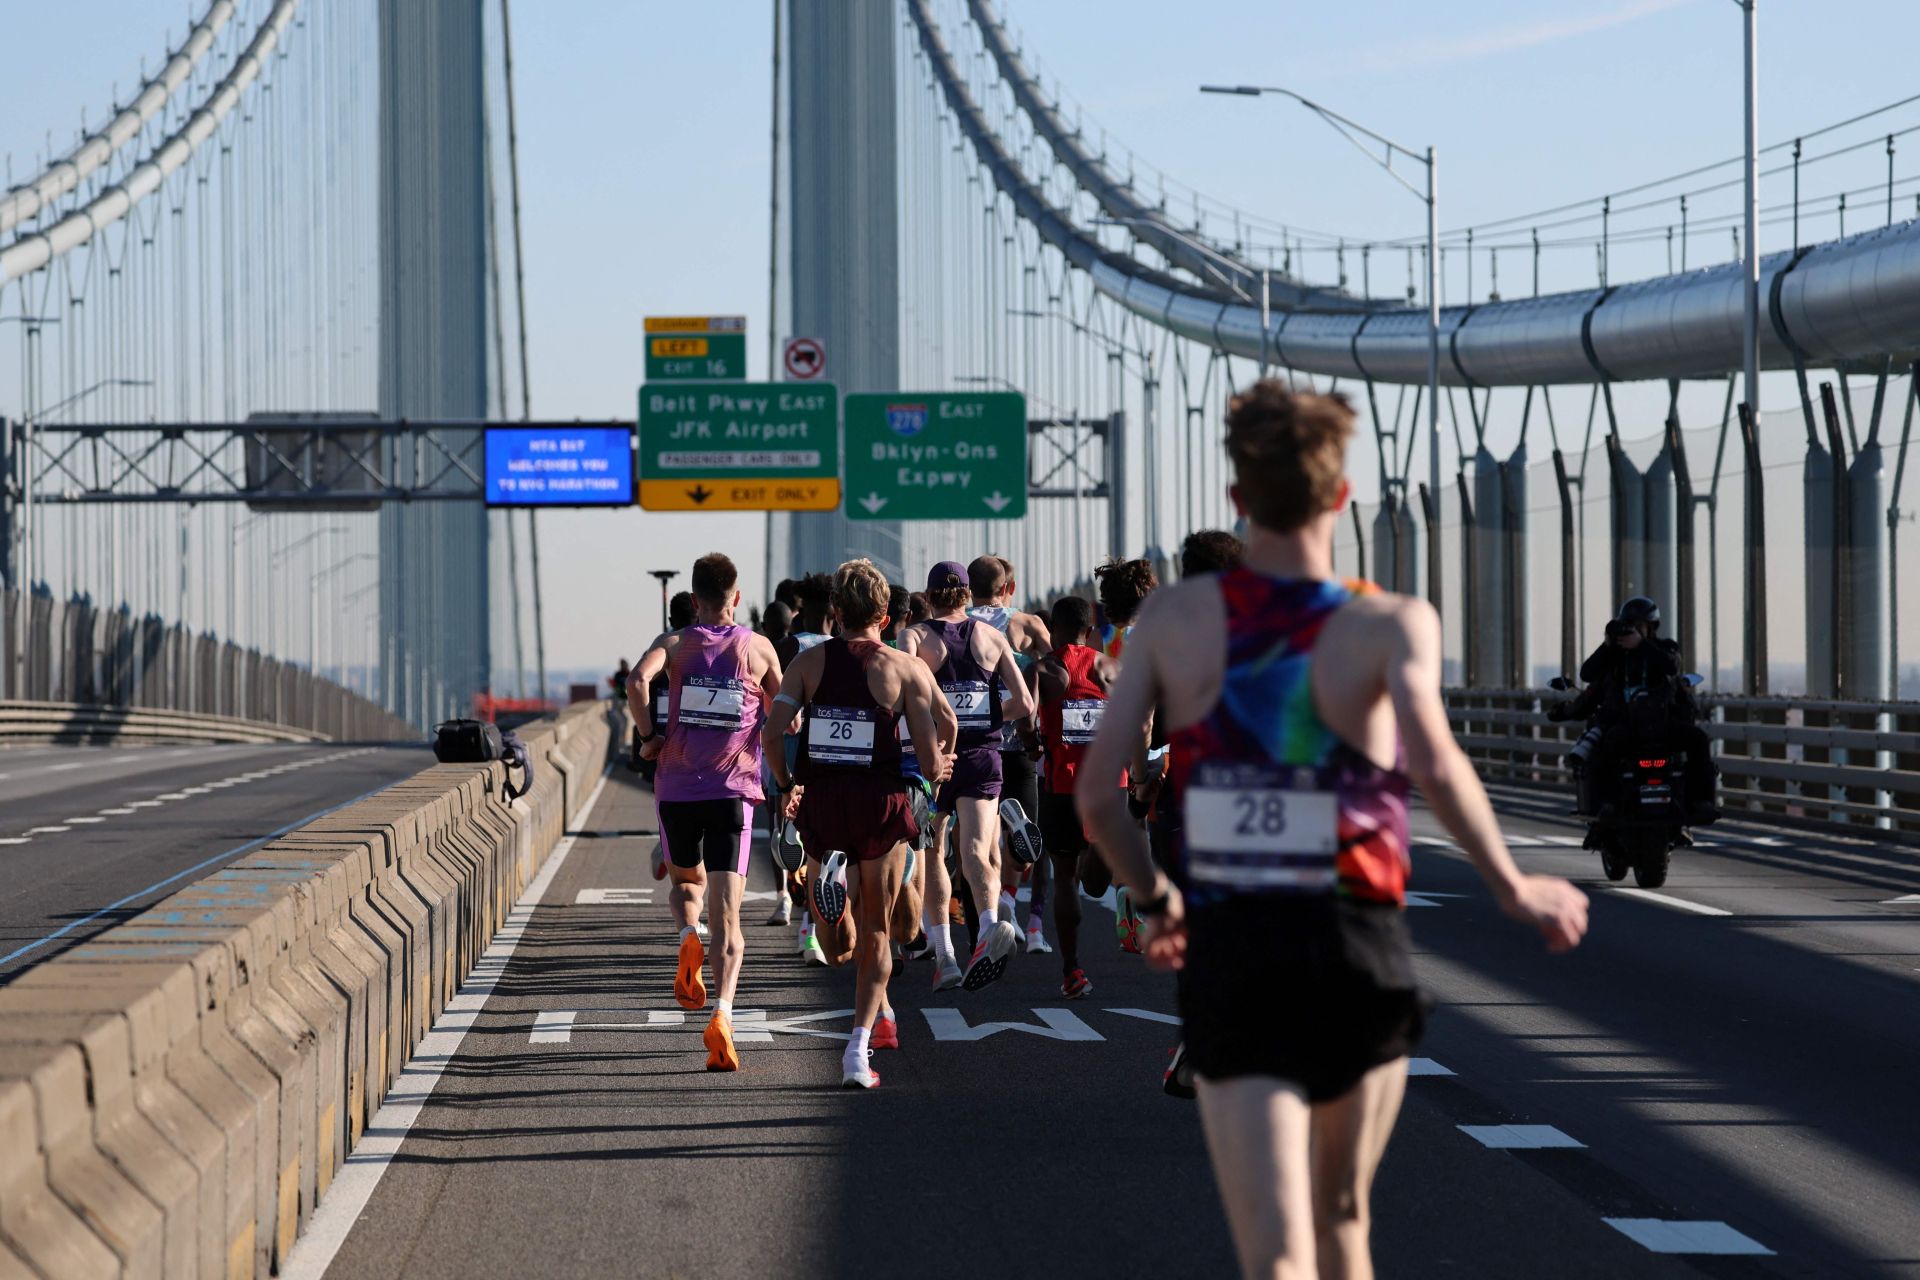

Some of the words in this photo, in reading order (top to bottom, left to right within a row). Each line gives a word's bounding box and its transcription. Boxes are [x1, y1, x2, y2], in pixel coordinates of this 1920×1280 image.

[659, 341, 698, 354] LEFT
[663, 362, 693, 374] EXIT
[706, 360, 727, 375] 16
[650, 395, 695, 412] Belt
[708, 394, 768, 414] Pkwy
[779, 394, 826, 411] EAST
[939, 401, 984, 418] EAST
[670, 421, 712, 439] JFK
[725, 421, 809, 441] Airport
[507, 459, 578, 472] WELCOMES
[582, 458, 608, 472] YOU
[665, 454, 734, 464] PASSENGER
[741, 454, 773, 464] CARS
[781, 454, 813, 464] ONLY
[549, 478, 619, 490] MARATHON
[897, 468, 972, 488] Expwy
[731, 487, 767, 501] EXIT
[776, 487, 818, 501] ONLY
[708, 689, 718, 706] 7
[955, 693, 974, 709] 22
[1082, 710, 1092, 725] 4
[829, 721, 853, 740] 26
[1233, 793, 1286, 836] 28
